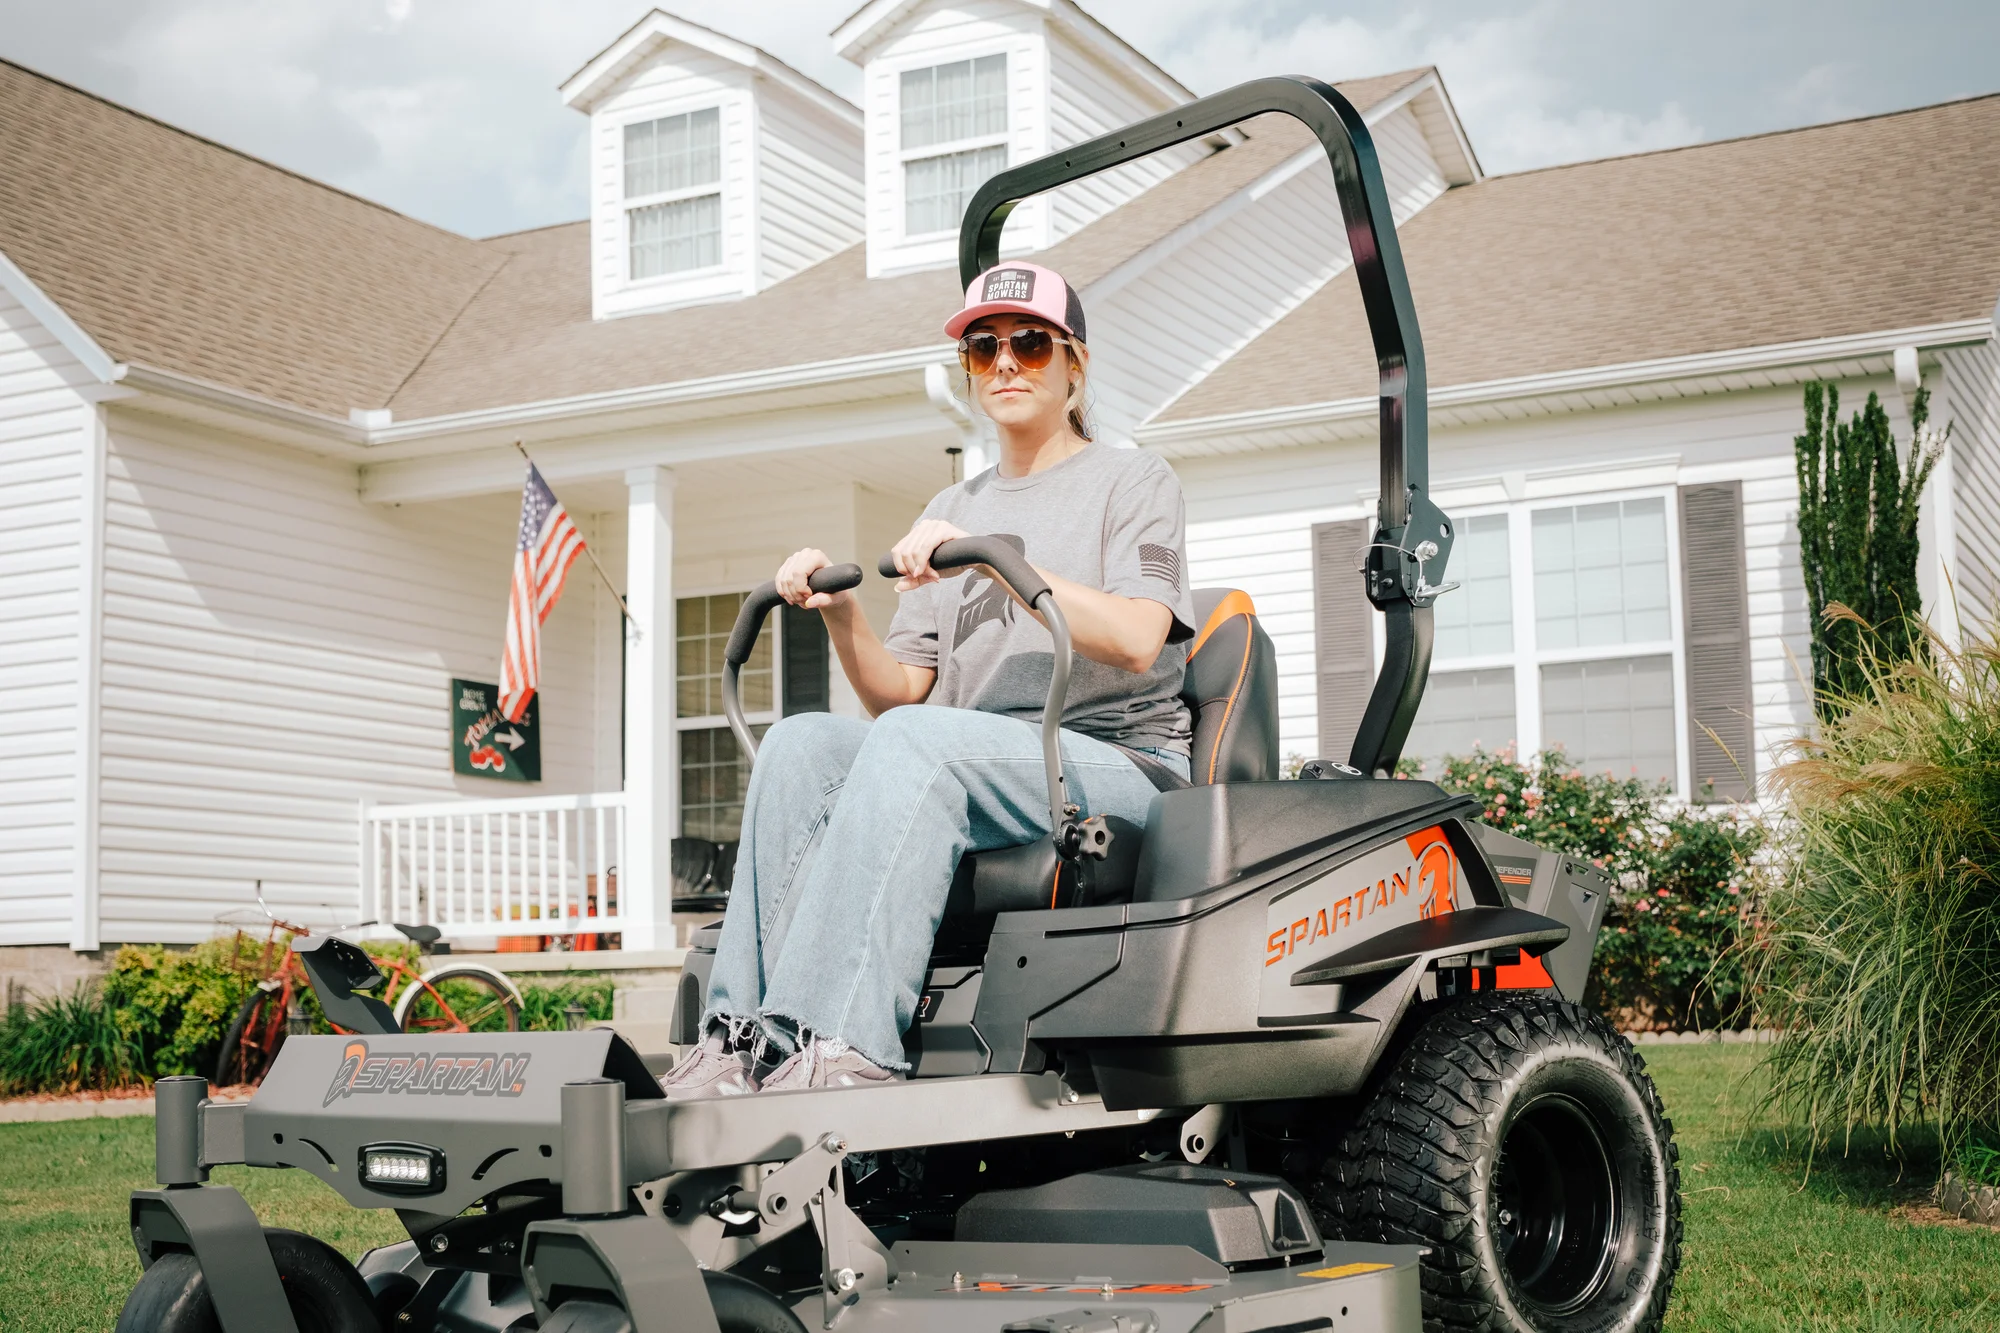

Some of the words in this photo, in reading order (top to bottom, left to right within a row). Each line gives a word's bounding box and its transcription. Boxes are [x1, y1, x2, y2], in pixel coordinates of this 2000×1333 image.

[986, 289, 1027, 301] MOWERS
[988, 280, 1028, 293] SPARTAN
[1265, 865, 1412, 967] SPARTAN
[352, 1056, 527, 1092] SPARTAN
